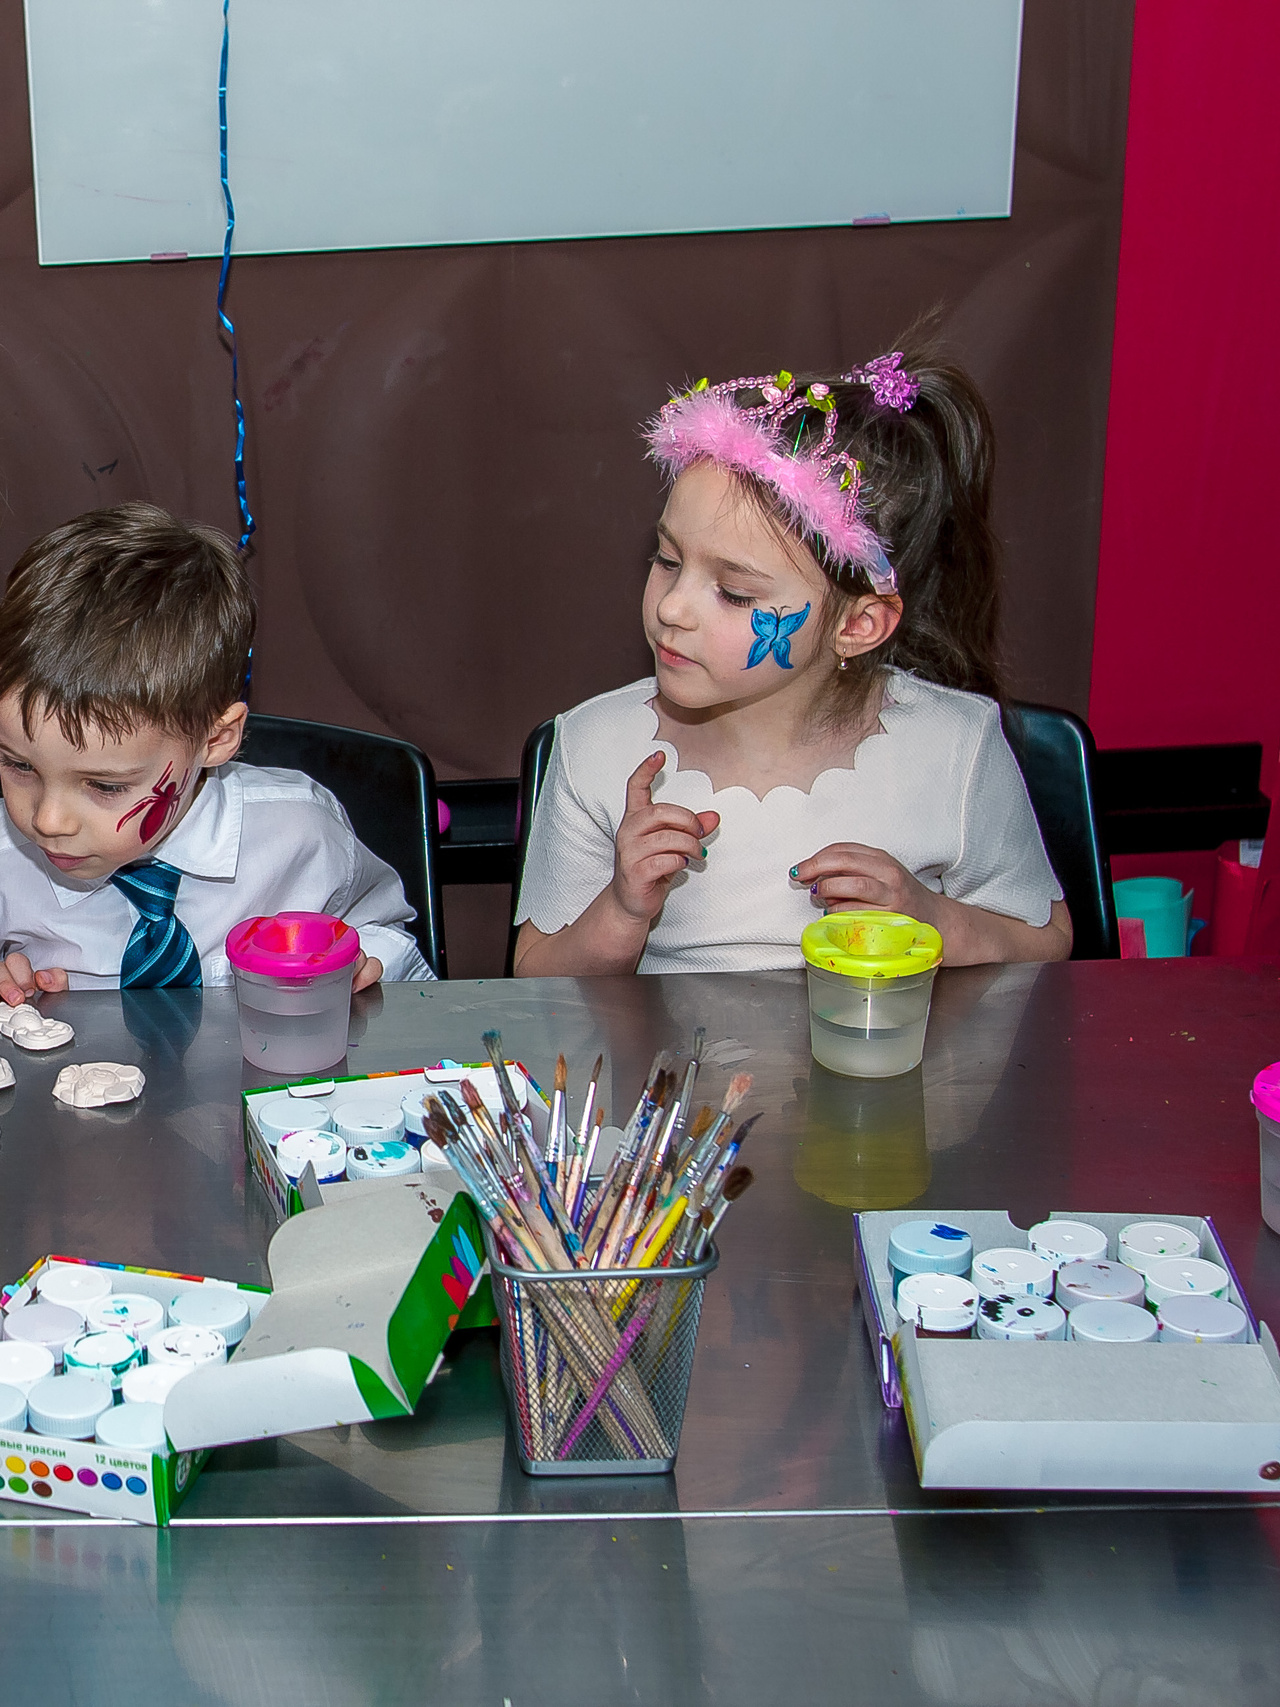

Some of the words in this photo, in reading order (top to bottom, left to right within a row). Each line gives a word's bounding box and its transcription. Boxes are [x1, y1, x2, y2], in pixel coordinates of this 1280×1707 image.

[25, 1443, 67, 1459] краски
[94, 1453, 107, 1465] 12
[108, 1456, 148, 1472] цветов
